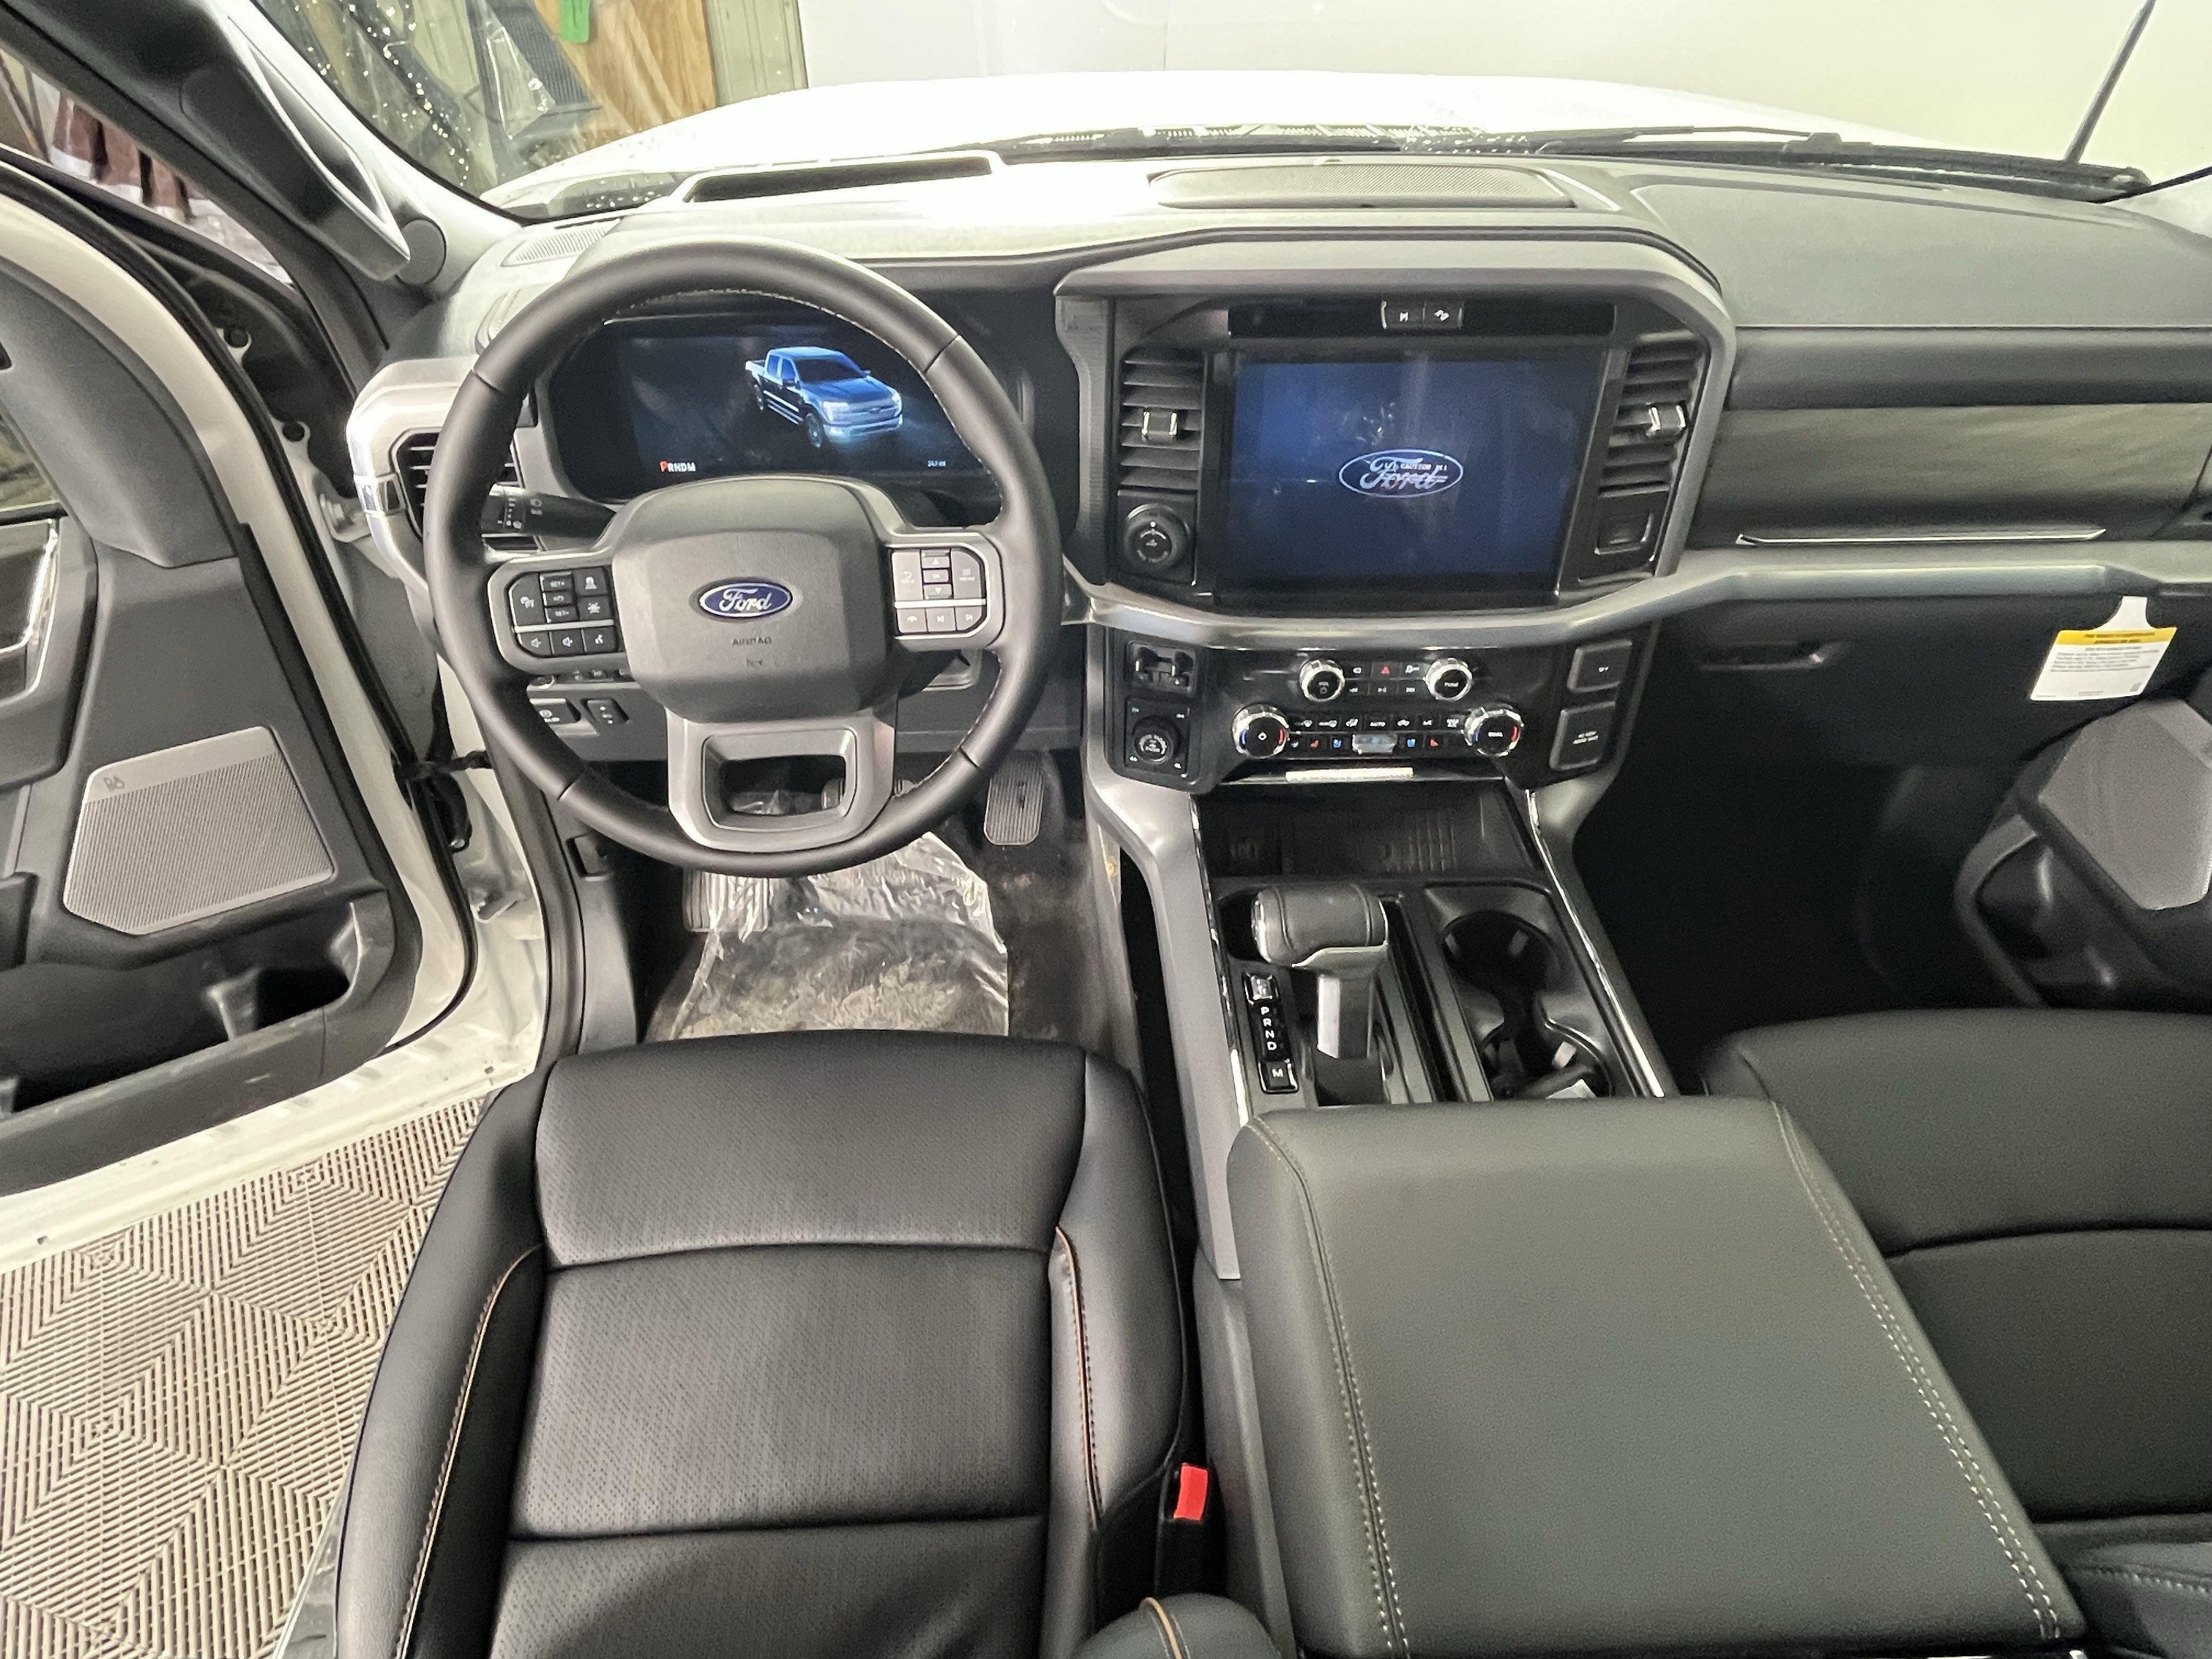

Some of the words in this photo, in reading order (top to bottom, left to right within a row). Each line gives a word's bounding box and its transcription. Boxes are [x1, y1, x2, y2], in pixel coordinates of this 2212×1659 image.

[1359, 456, 1443, 489] Ford
[719, 588, 772, 612] Ford
[1261, 1006, 1269, 1015] P
[1263, 1018, 1272, 1026] R
[1265, 1030, 1274, 1039] N
[1267, 1041, 1277, 1051] D
[1272, 1068, 1284, 1077] M
